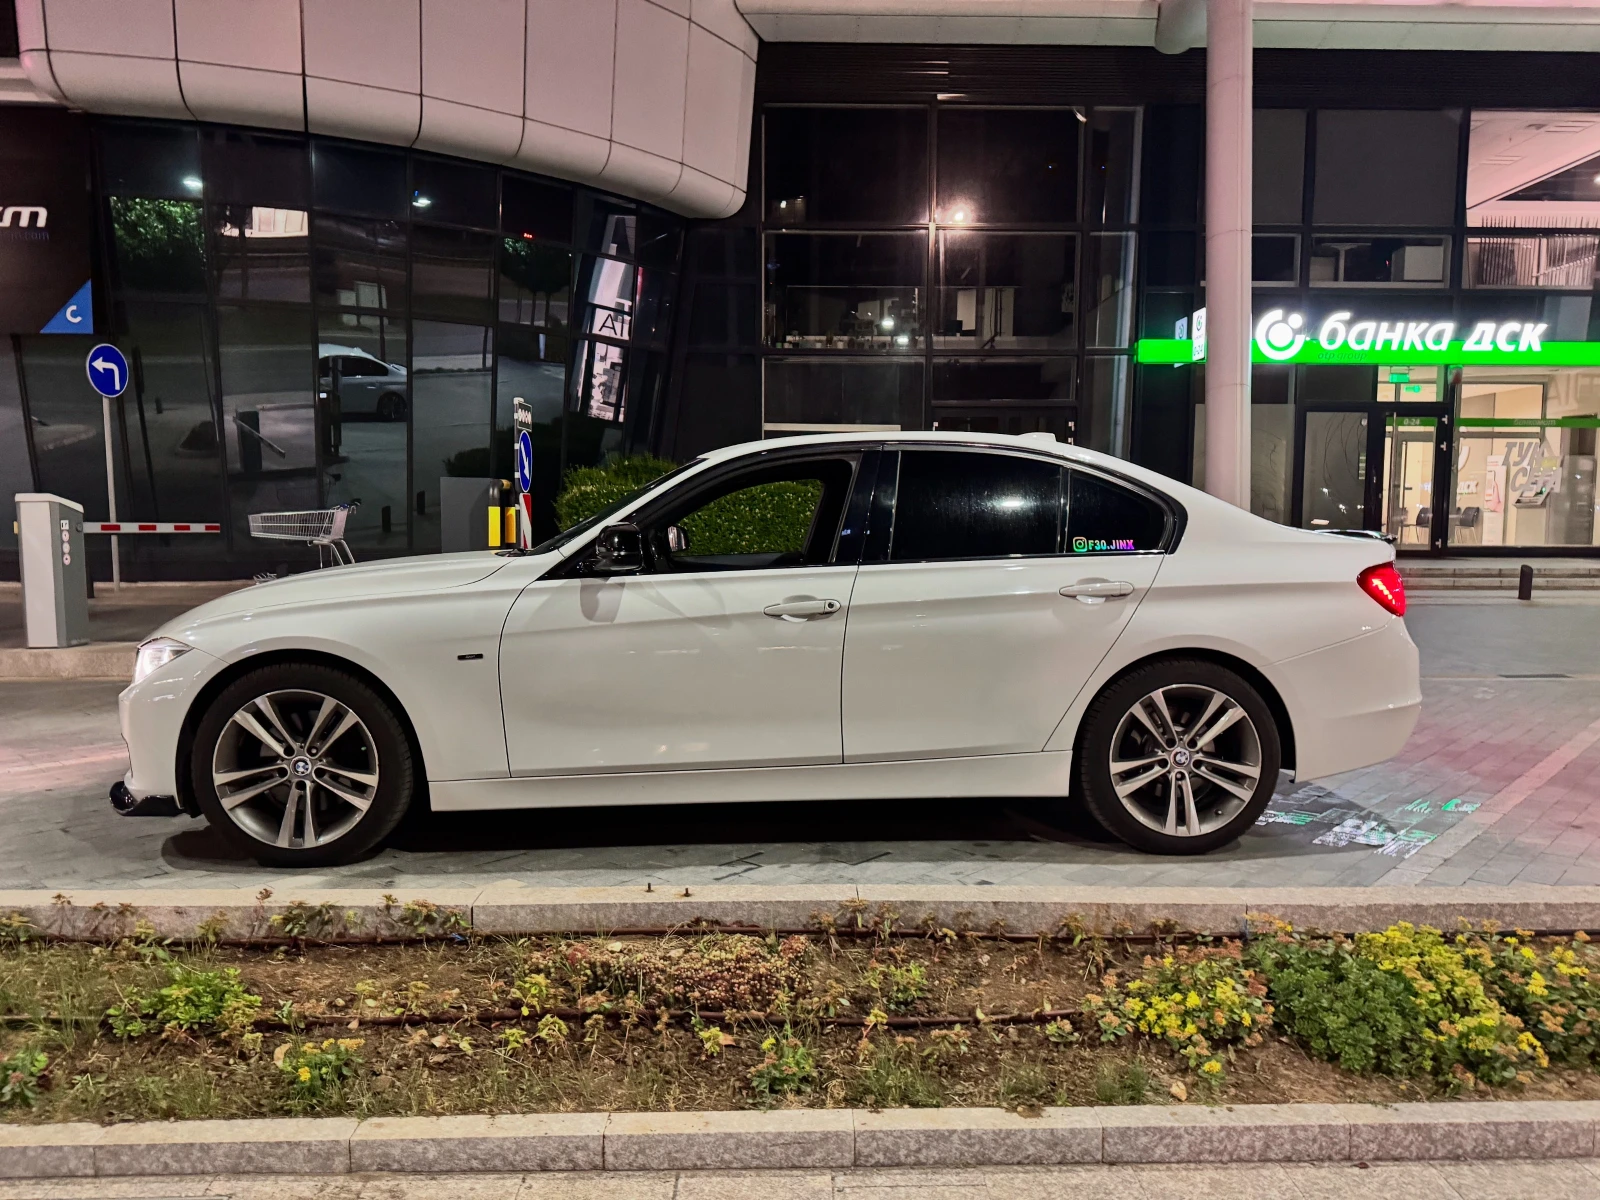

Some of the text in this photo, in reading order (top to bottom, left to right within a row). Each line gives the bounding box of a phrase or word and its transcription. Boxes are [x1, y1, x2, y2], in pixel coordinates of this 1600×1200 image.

[1319, 311, 1455, 352] банка
[1336, 352, 1367, 361] group
[1403, 418, 1420, 426] 0-24
[1087, 539, 1135, 551] F30.JINX
